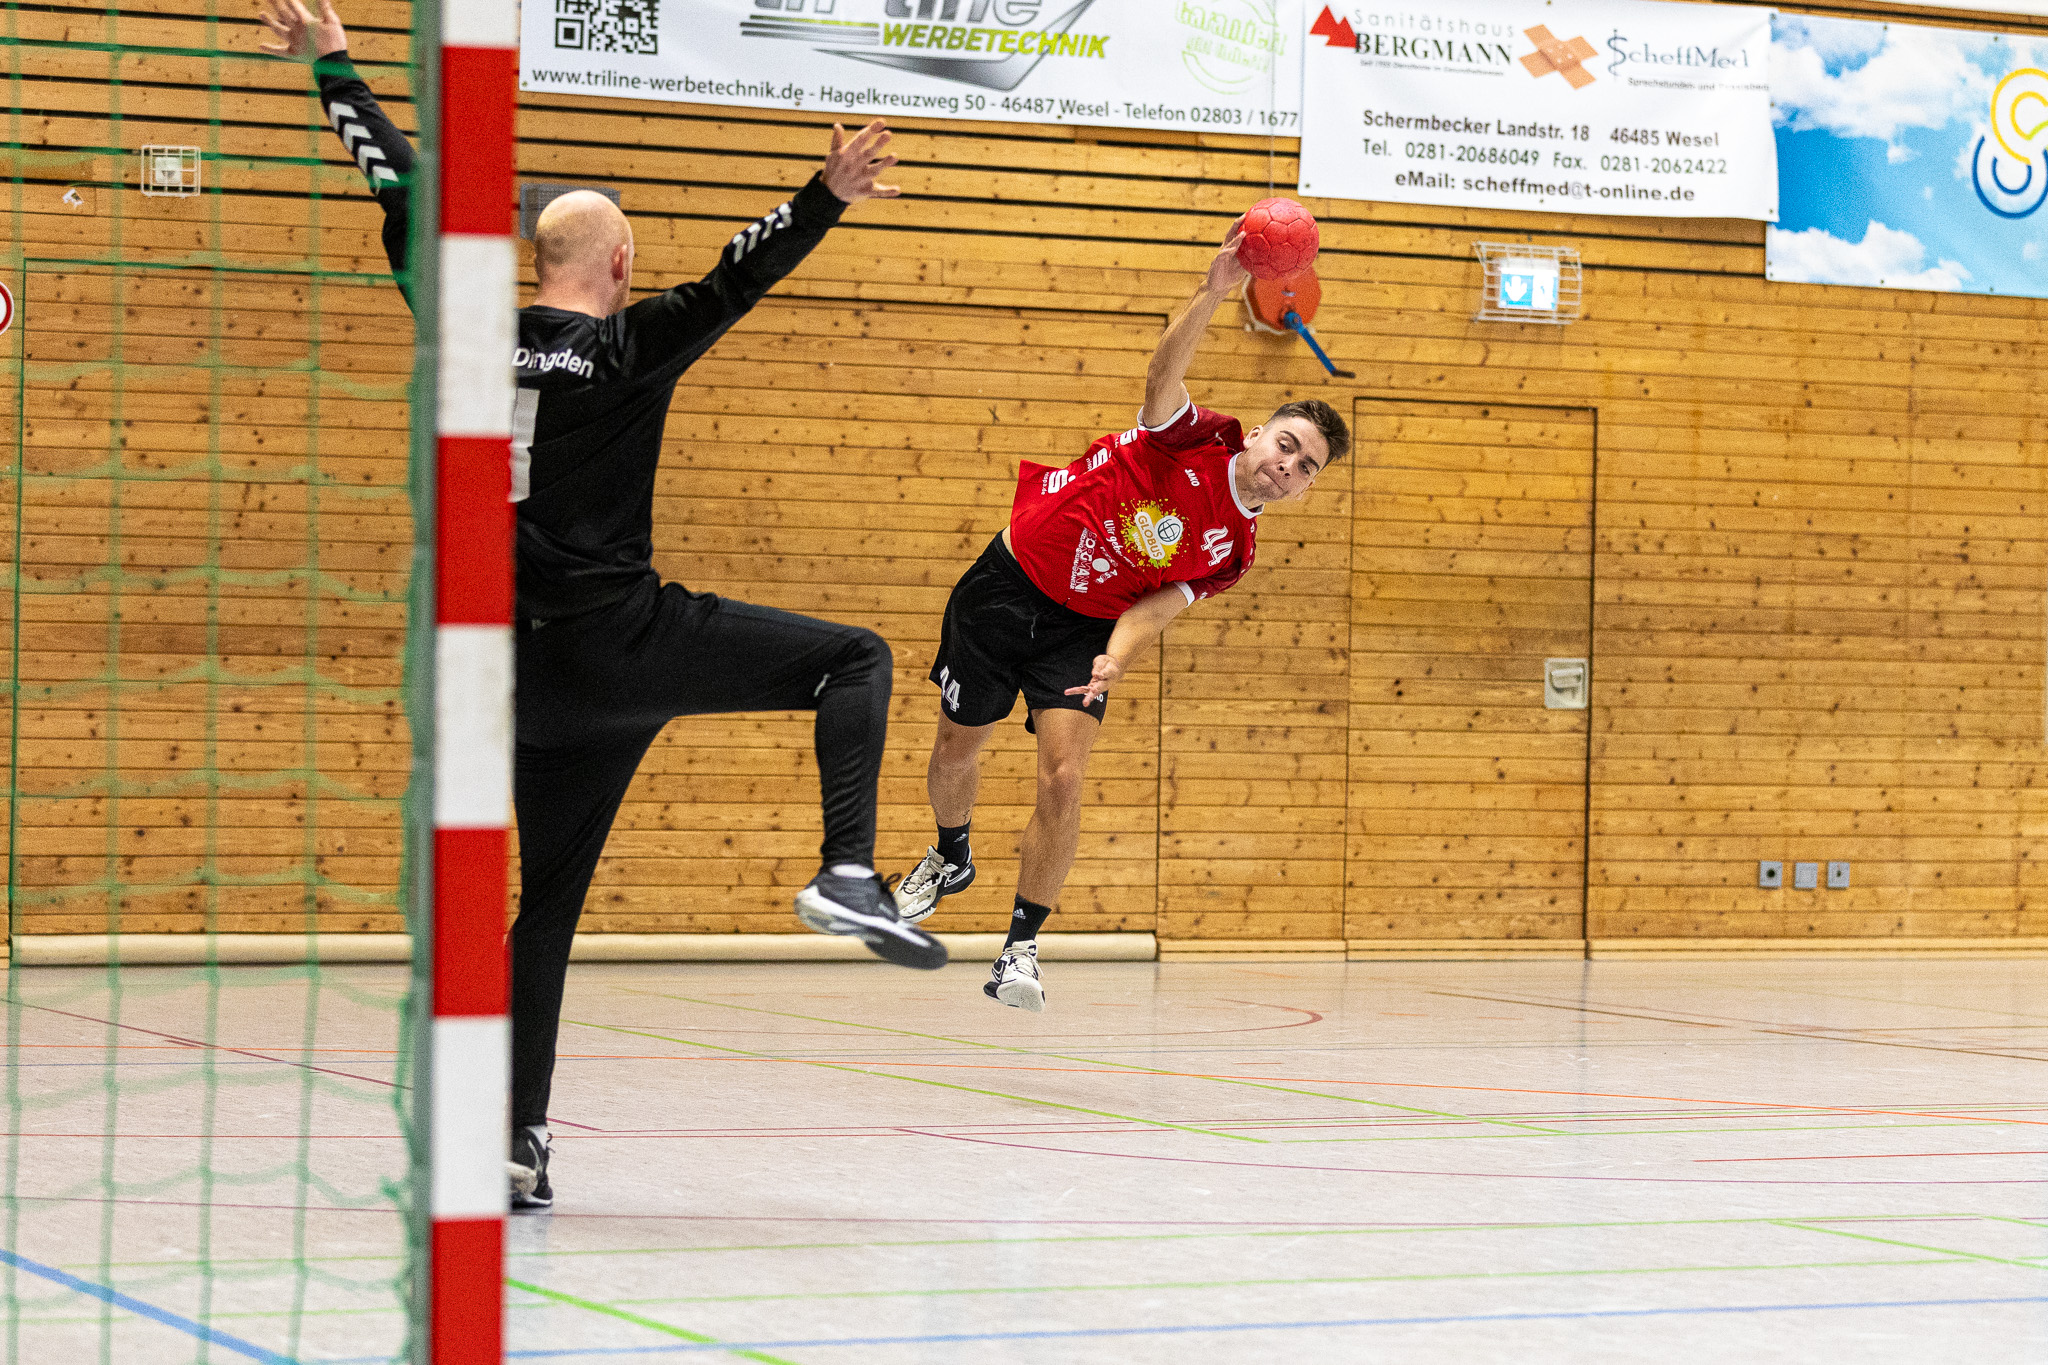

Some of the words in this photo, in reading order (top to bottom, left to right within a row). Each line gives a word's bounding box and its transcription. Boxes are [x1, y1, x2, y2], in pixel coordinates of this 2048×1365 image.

[883, 21, 1111, 60] WERBETECHNIK
[1354, 9, 1514, 38] Sanitätshaus
[1354, 32, 1512, 66] BERGMANN
[1606, 29, 1749, 77] ScheffMed
[532, 67, 804, 101] www.triline-werbetechnik.de
[820, 86, 959, 112] Hagelkreuzweg
[964, 94, 986, 111] 50
[1000, 96, 1054, 114] 46487
[1061, 100, 1109, 118] Wesel
[1125, 103, 1186, 122] Telefon
[1190, 107, 1242, 125] 02803
[1258, 110, 1298, 128] 1677
[1363, 110, 1492, 135] Schermbecker
[1497, 119, 1564, 141] Landstr.
[1571, 125, 1590, 142] 18
[1609, 127, 1660, 147] 46485
[1665, 131, 1720, 148] Wesel
[1362, 139, 1392, 157] Tel.
[1405, 141, 1540, 166] 0281-20686049
[1553, 152, 1588, 171] Fax.
[1600, 155, 1728, 175] 0281-2062422
[1394, 171, 1456, 190] eMail:
[1462, 176, 1696, 202] scheffmed@t-online.de
[511, 347, 595, 379] Dingden
[1184, 468, 1200, 488] JAKO
[1103, 519, 1116, 536] Wir
[1137, 515, 1163, 558] GLOBUS
[1106, 535, 1124, 557] gebe
[1200, 525, 1235, 567] 44
